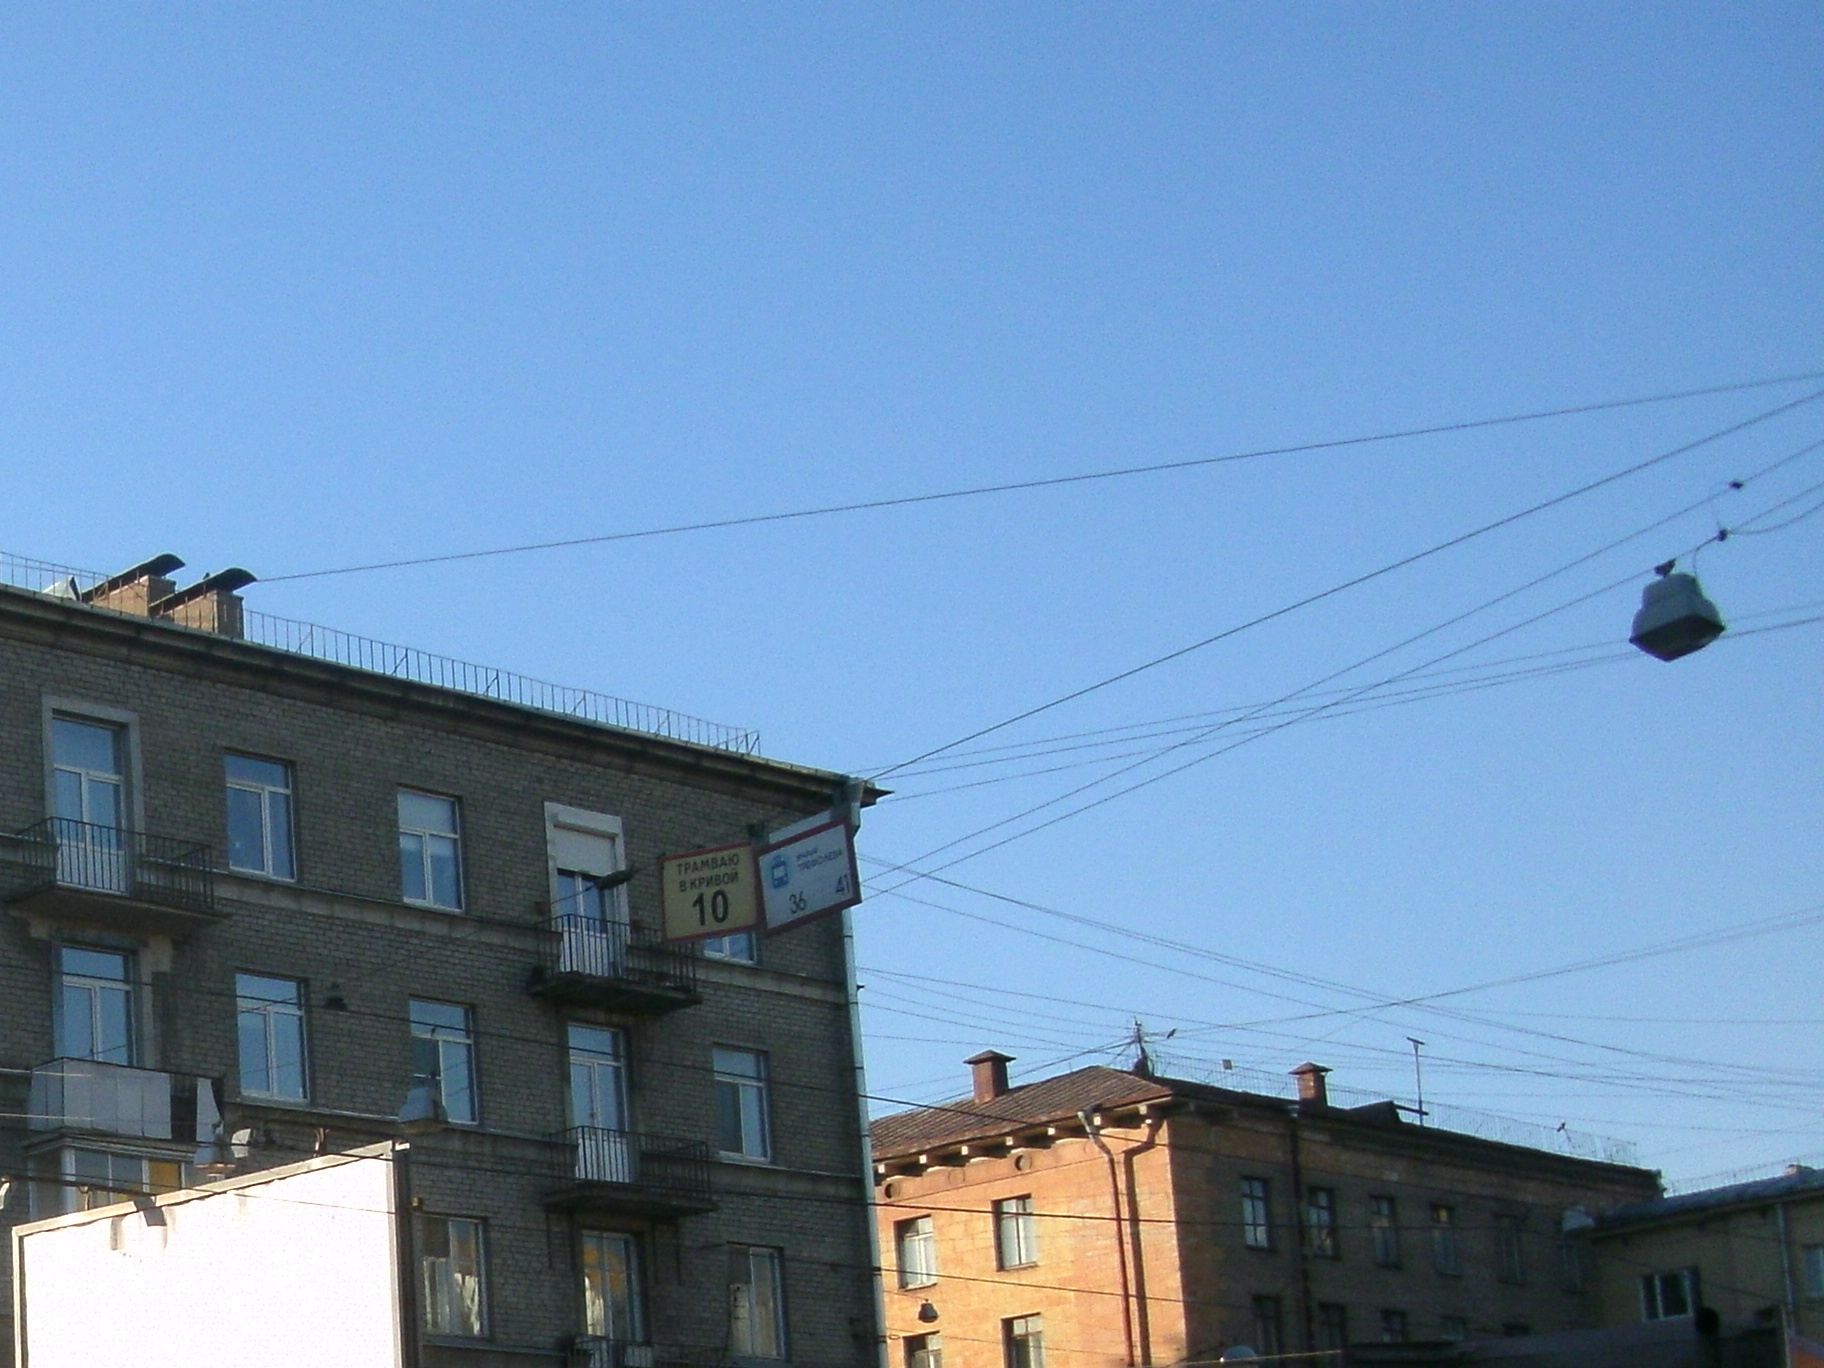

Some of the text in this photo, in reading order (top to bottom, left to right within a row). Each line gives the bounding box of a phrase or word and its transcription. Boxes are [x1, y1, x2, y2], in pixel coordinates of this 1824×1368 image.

[677, 853, 740, 876] ТРАМВАЮ
[679, 867, 739, 892] В КРИВОЙ
[692, 890, 729, 926] 10
[789, 874, 850, 914] 36 41
